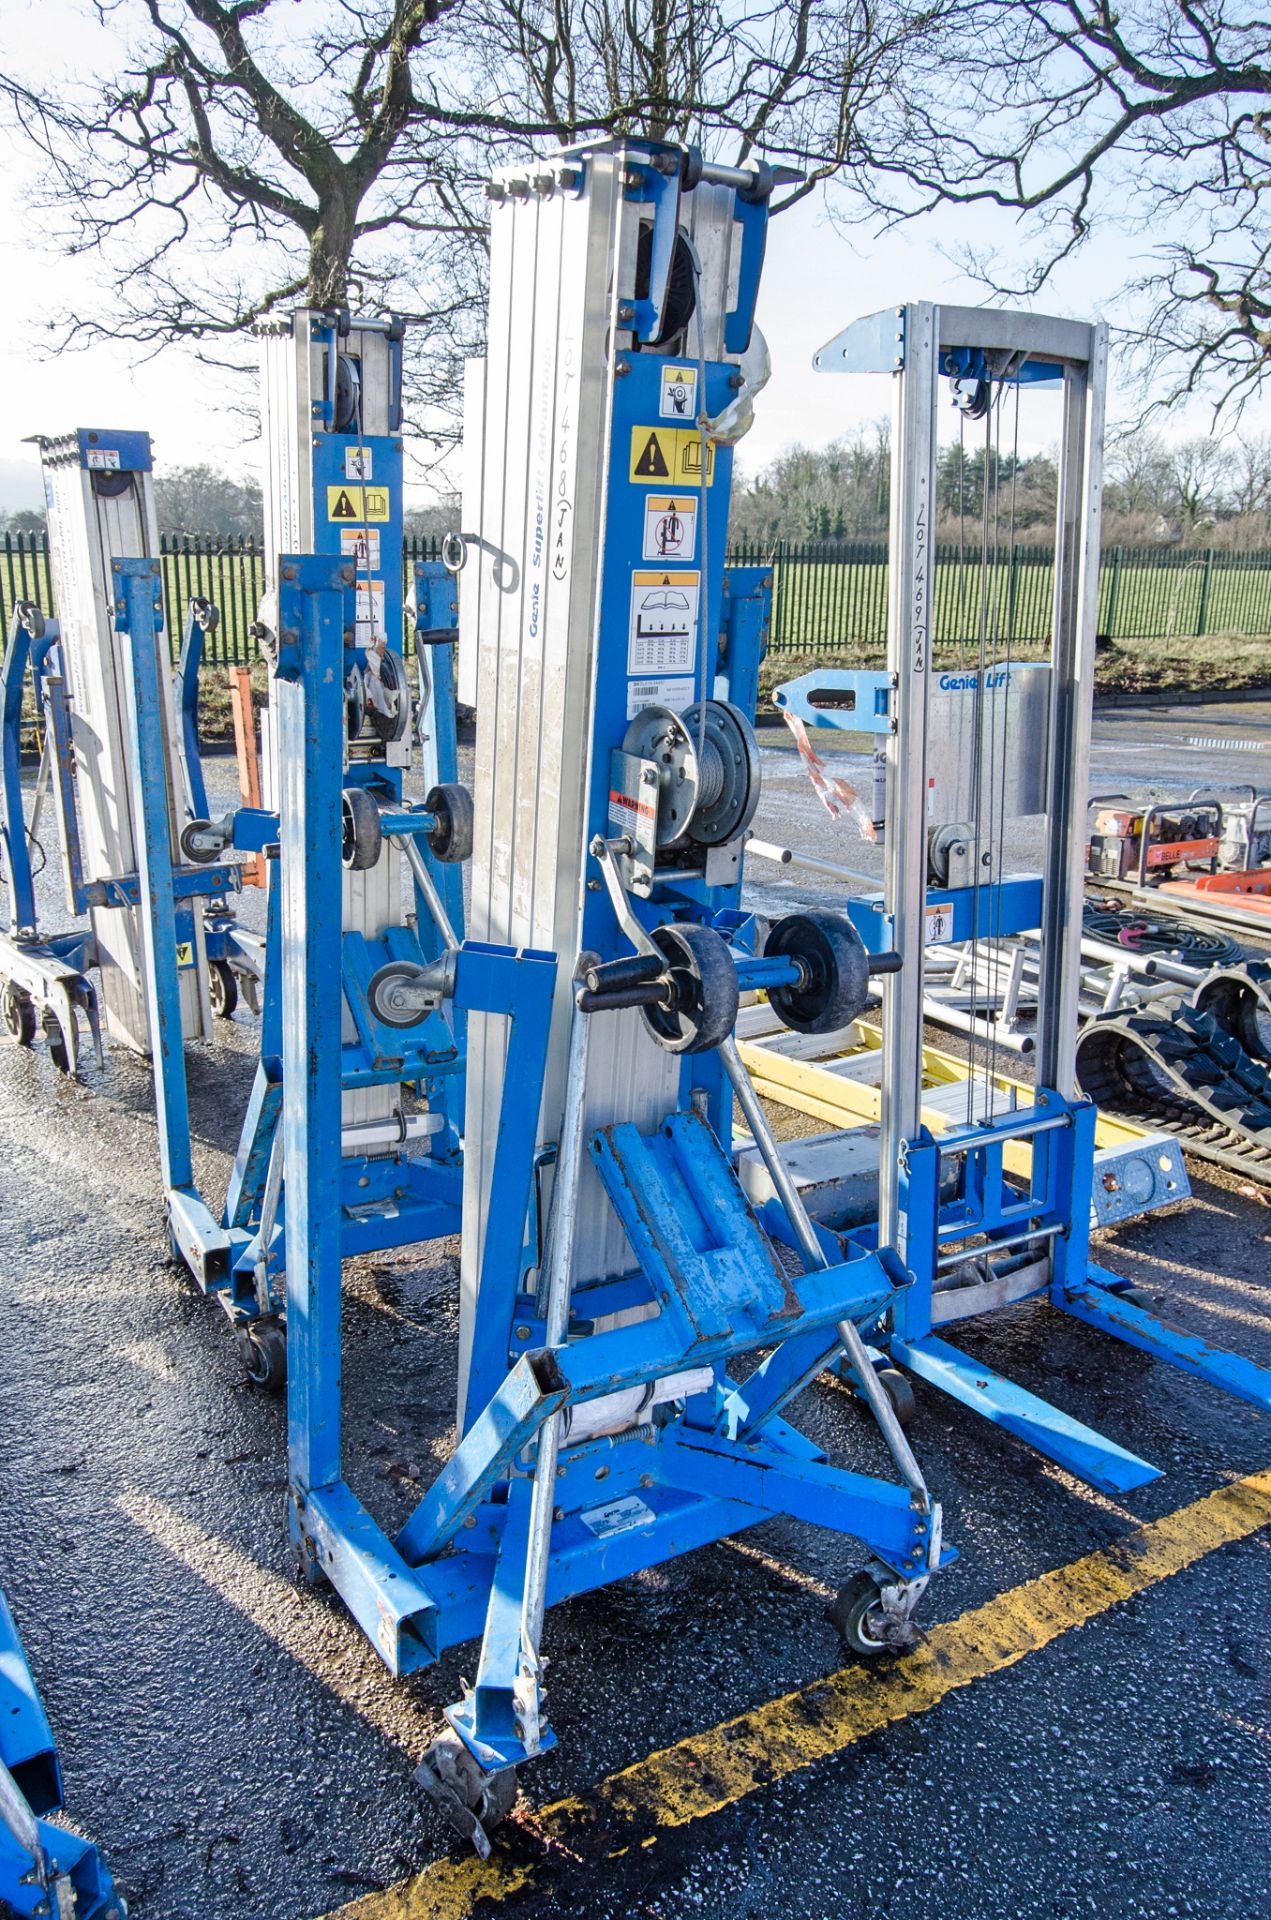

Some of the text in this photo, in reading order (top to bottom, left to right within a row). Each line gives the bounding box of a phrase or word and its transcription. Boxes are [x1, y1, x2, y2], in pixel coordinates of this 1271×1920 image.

[563, 321, 575, 394] LOT
[532, 470, 544, 568] Superlift
[916, 510, 926, 558] LOT
[529, 583, 540, 638] Genie
[940, 672, 1011, 690] Genie Lift
[623, 795, 649, 815] WARNING
[1161, 849, 1180, 861] BELLE
